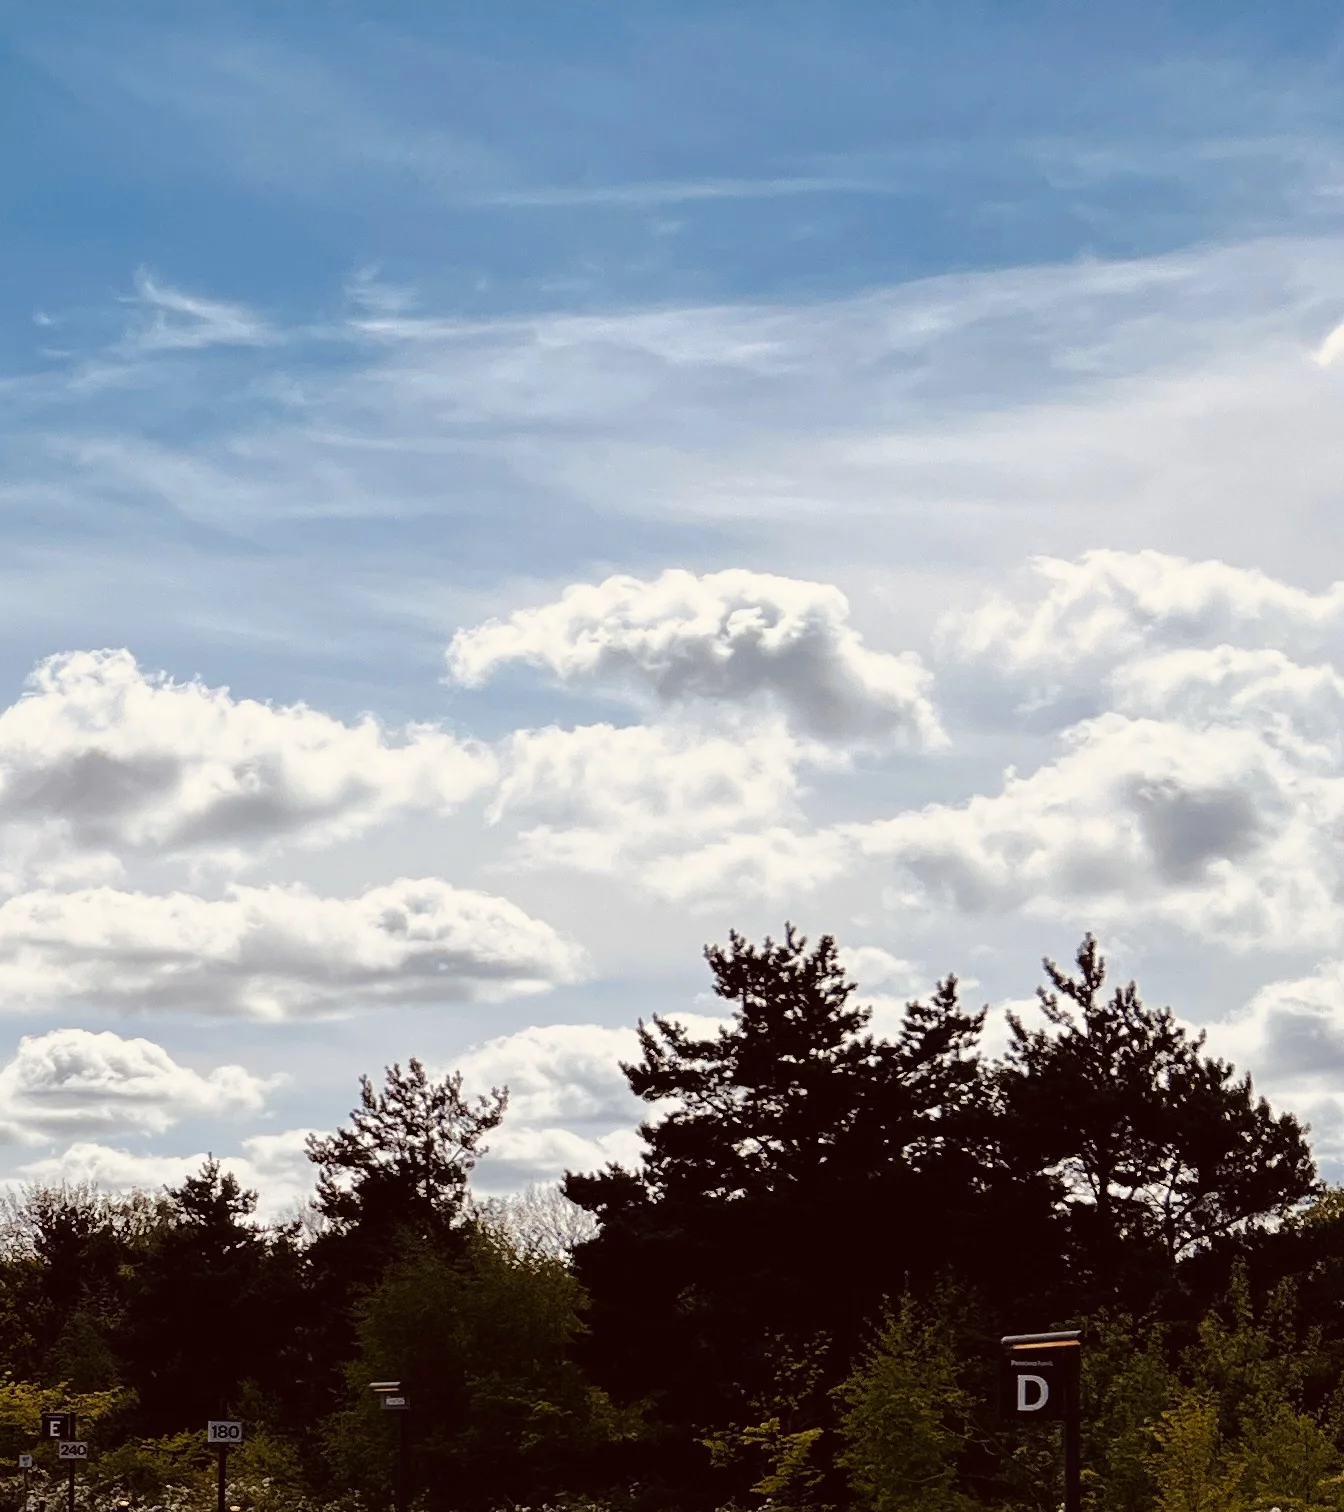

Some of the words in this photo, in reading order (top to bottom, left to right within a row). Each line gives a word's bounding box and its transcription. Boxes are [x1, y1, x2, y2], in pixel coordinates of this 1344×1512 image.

[1017, 1375, 1049, 1411] D
[50, 1421, 61, 1437] E
[212, 1425, 240, 1439] 180
[61, 1445, 87, 1456] 240
